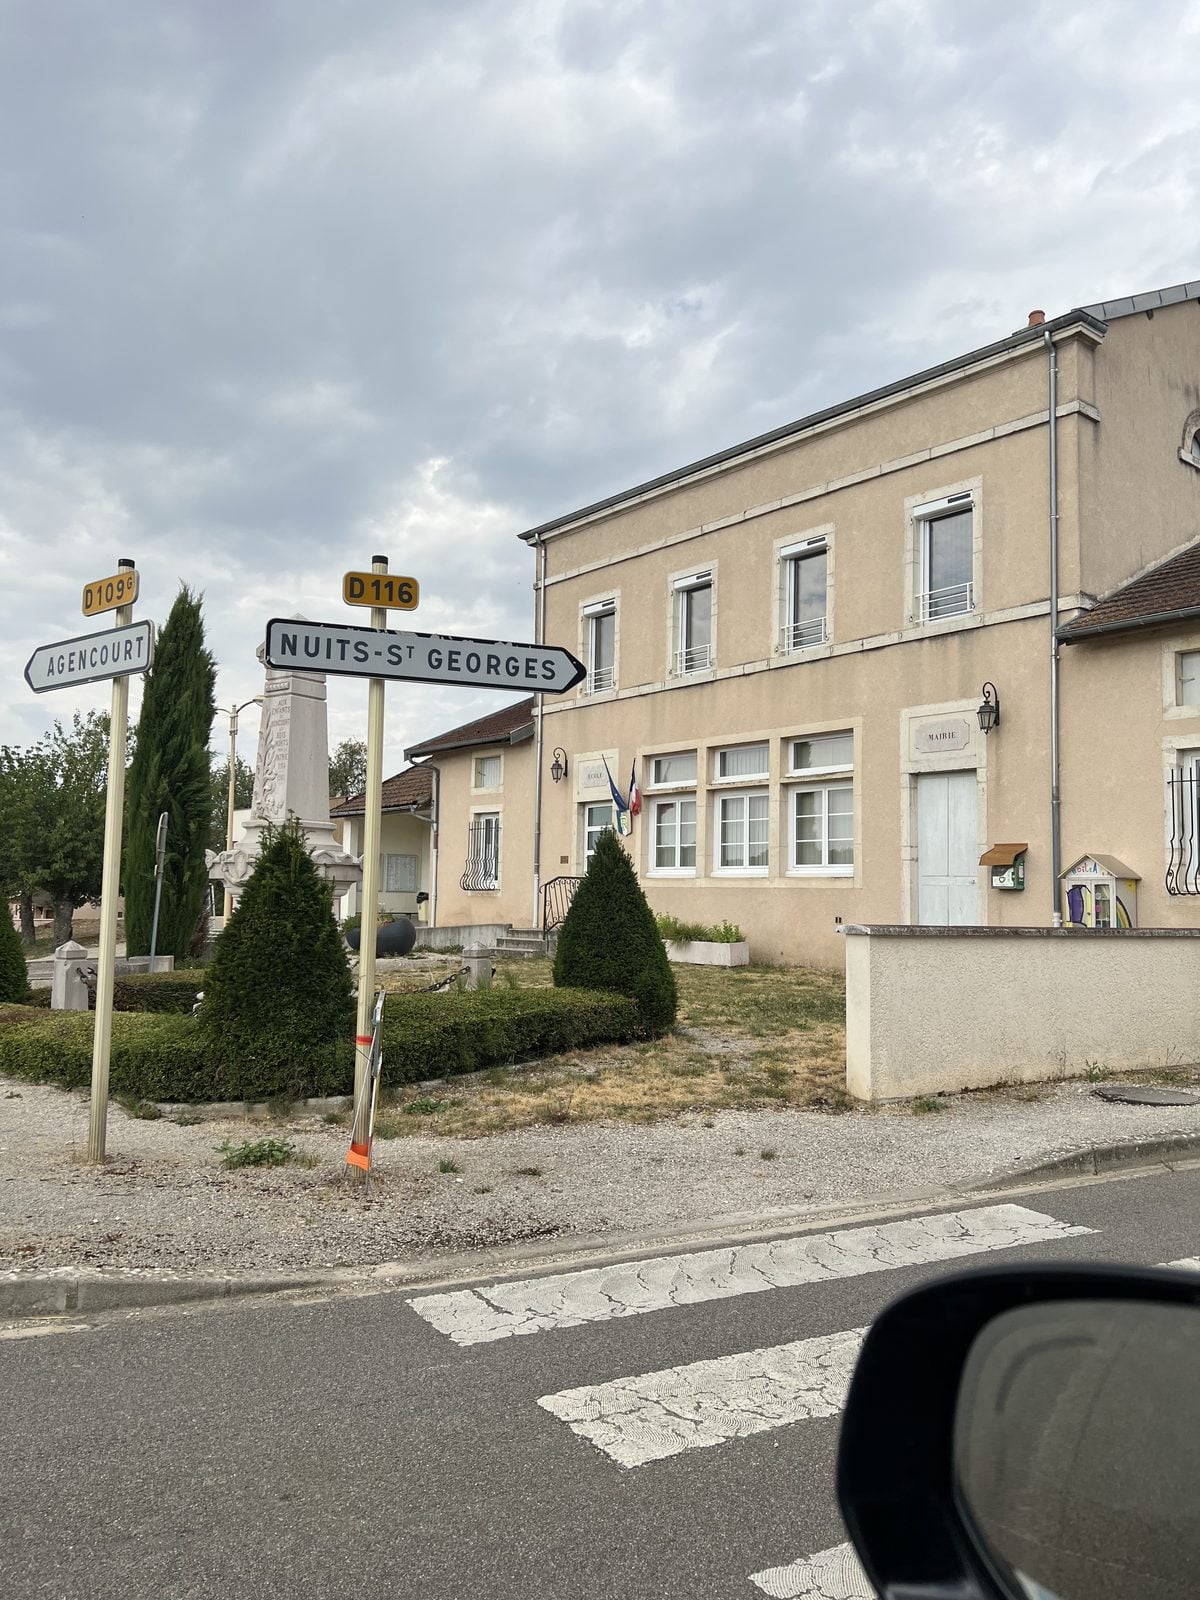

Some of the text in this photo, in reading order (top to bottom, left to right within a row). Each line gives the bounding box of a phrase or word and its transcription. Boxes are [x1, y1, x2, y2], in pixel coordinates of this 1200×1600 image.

[47, 636, 144, 677] AGENCOURT
[428, 648, 556, 681] GEORGES
[928, 731, 956, 741] MAIRIE
